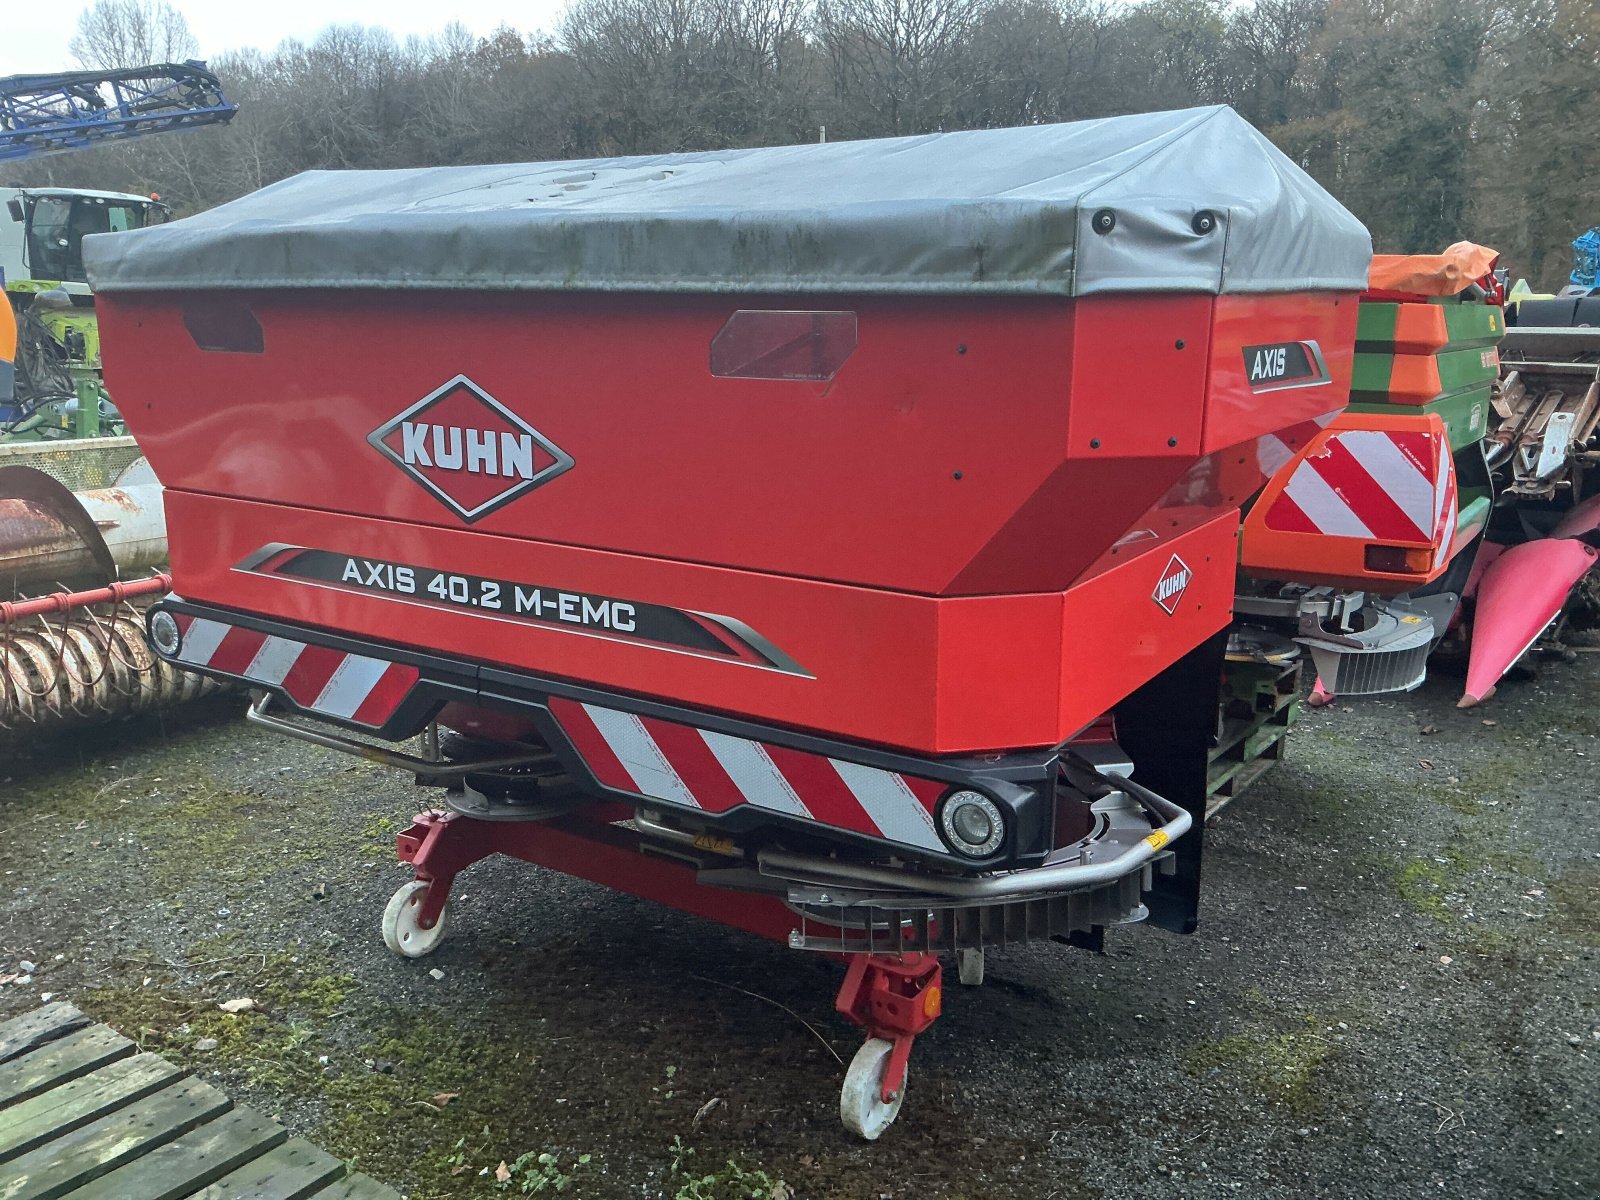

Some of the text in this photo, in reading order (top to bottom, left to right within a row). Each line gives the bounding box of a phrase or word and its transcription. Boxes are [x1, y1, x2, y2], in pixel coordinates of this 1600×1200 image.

[1251, 348, 1286, 380] AXIS
[402, 421, 534, 480] KUHN
[342, 558, 636, 632] AXIS 40.2 M-EMC
[1159, 569, 1187, 602] KUHN
